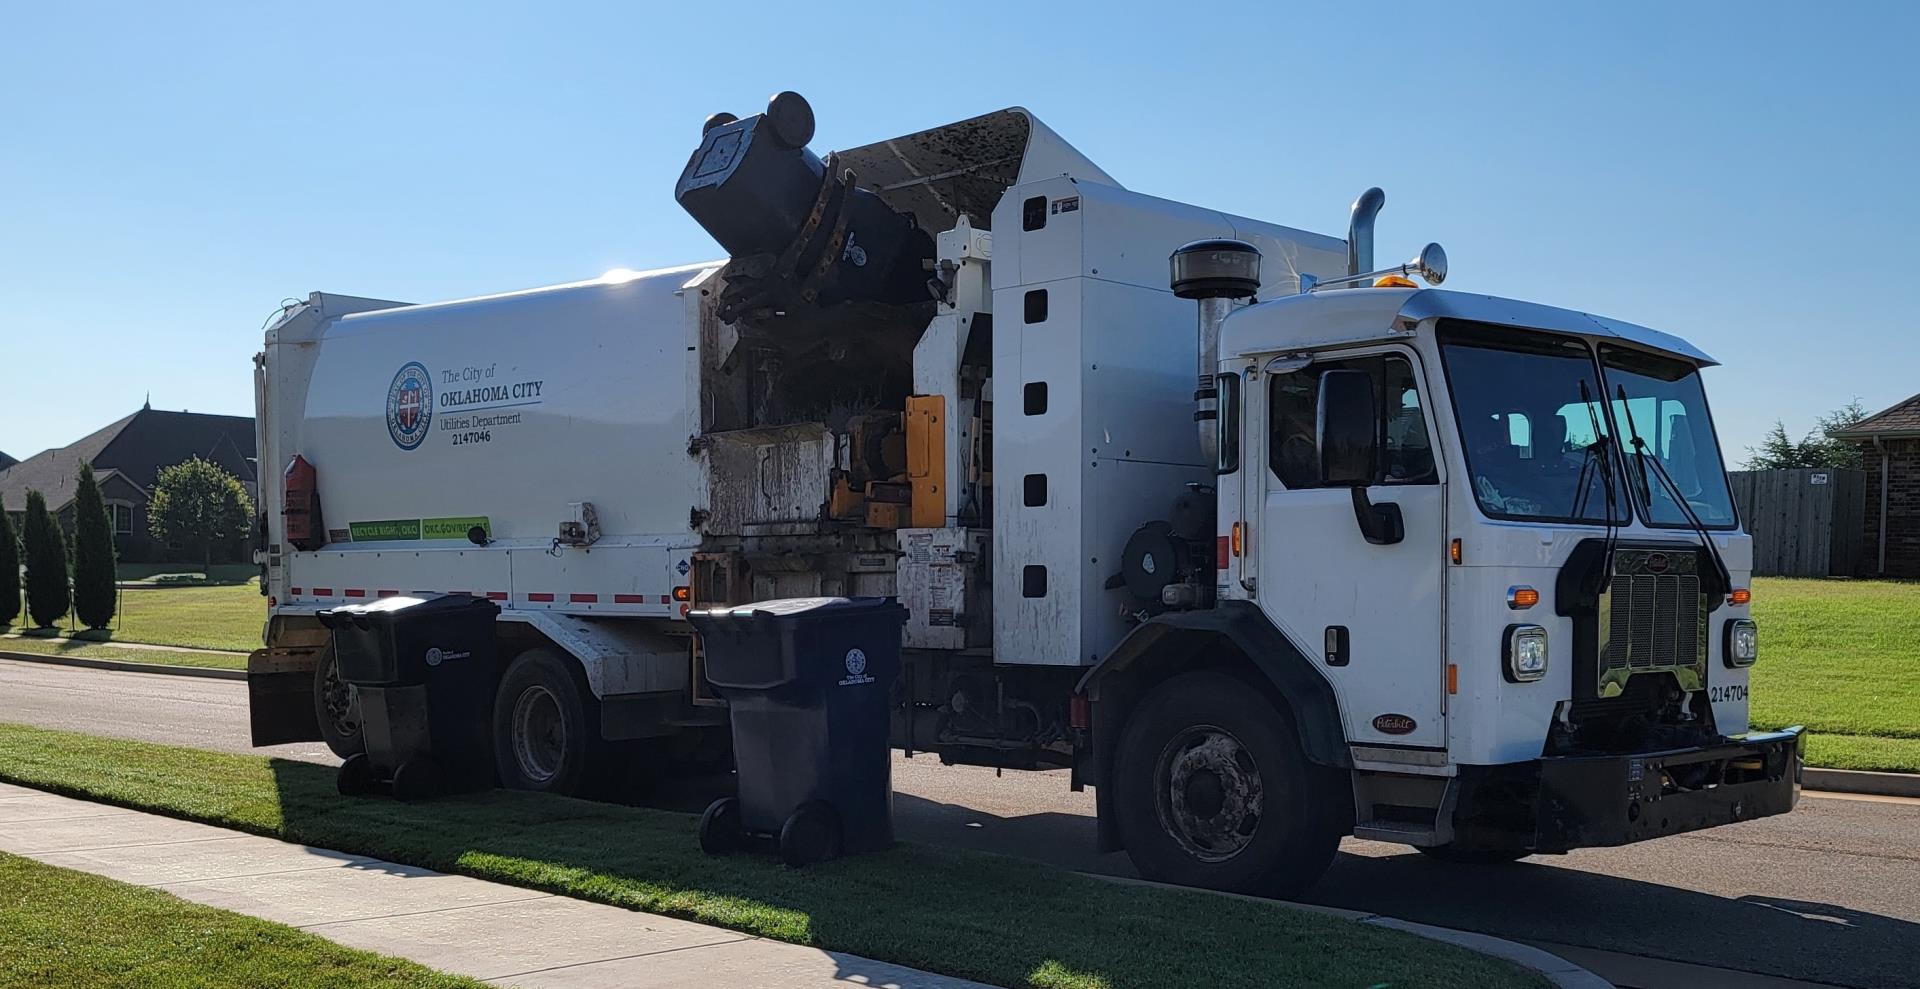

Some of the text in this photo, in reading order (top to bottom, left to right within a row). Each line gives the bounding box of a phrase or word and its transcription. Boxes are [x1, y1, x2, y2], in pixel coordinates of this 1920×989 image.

[442, 363, 497, 384] The City of
[440, 380, 543, 407] OKLAHOMA CITY
[440, 412, 521, 431] Utilities Department
[452, 430, 491, 445] 2147046
[352, 527, 379, 537] RECYCLE
[1377, 717, 1412, 728] Peterbilt
